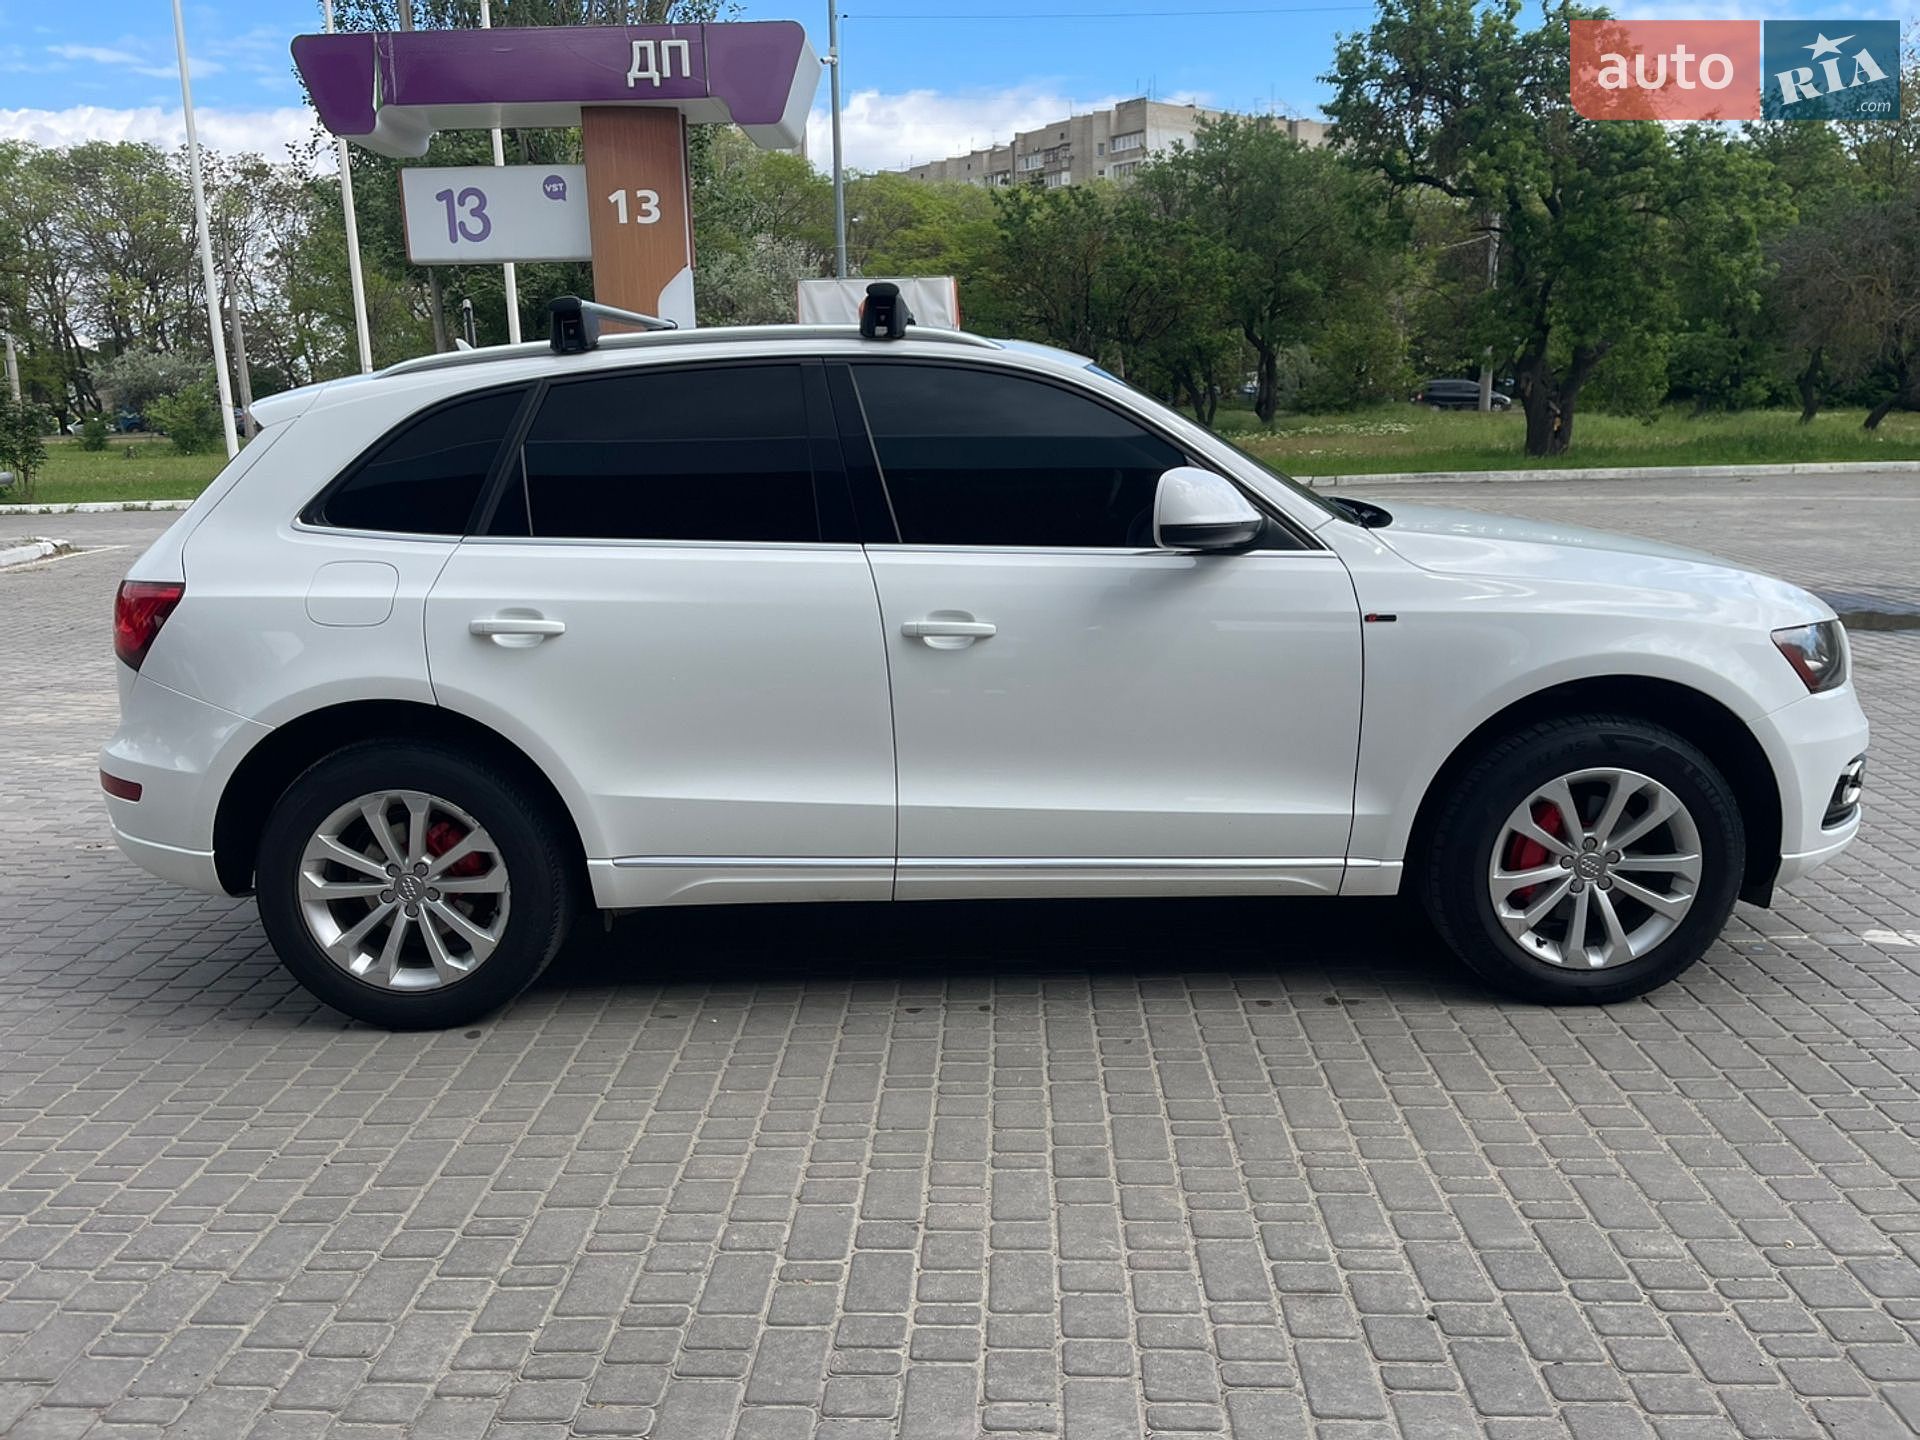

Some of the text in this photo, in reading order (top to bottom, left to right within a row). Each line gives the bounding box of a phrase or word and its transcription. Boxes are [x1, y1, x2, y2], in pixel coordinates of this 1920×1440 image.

[627, 39, 691, 88] ДП
[544, 182, 564, 192] VST
[608, 188, 661, 225] 13
[435, 187, 492, 244] 13
